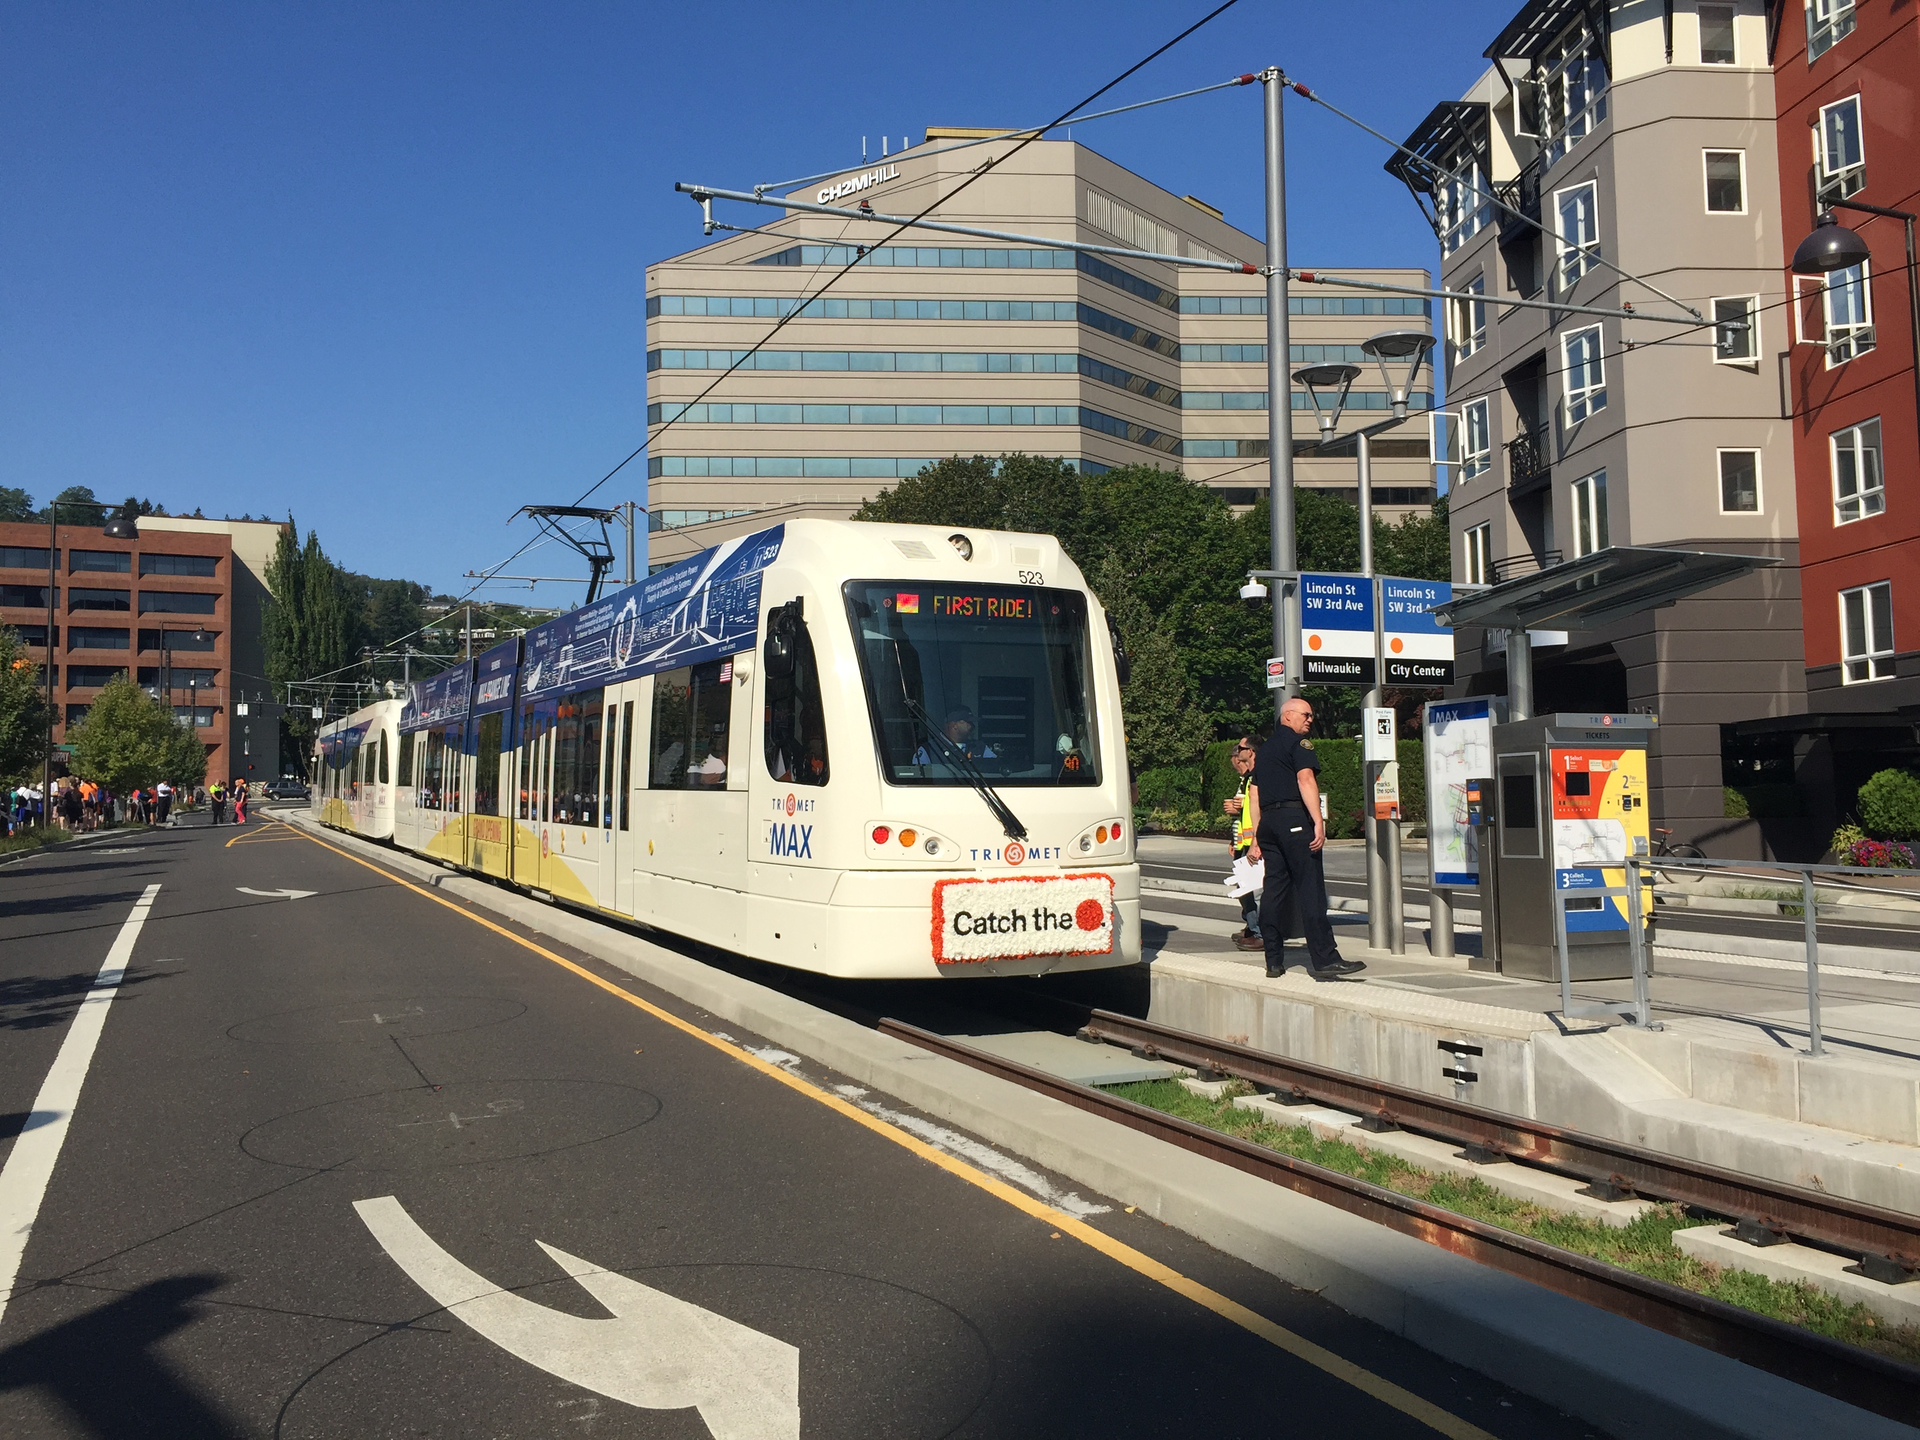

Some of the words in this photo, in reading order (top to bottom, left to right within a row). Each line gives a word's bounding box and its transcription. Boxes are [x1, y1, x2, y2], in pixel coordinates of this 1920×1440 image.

[763, 544, 779, 560] 523
[1018, 570, 1045, 585] 523
[1306, 582, 1342, 595] Lincoln
[1345, 584, 1356, 596] St
[1388, 586, 1423, 599] Lincoln
[1425, 588, 1436, 600] St
[933, 595, 984, 616] FIRST
[987, 598, 1032, 618] RIDE!
[1306, 598, 1323, 610] SW
[1325, 598, 1342, 611] 3rd
[1344, 600, 1364, 612] Ave
[1388, 601, 1404, 613] SW
[1406, 602, 1423, 614] 3rd
[1308, 662, 1361, 675] Milwaukie
[1390, 664, 1410, 678] City
[1412, 665, 1446, 677] Center
[1435, 710, 1459, 723] MAX
[1585, 732, 1610, 740] TICKETS
[1564, 755, 1570, 770] 1
[1622, 775, 1629, 789] 2
[770, 822, 814, 859] MAX
[1562, 873, 1570, 888] 3
[953, 908, 1027, 936] Catch
[1032, 907, 1073, 931] the
